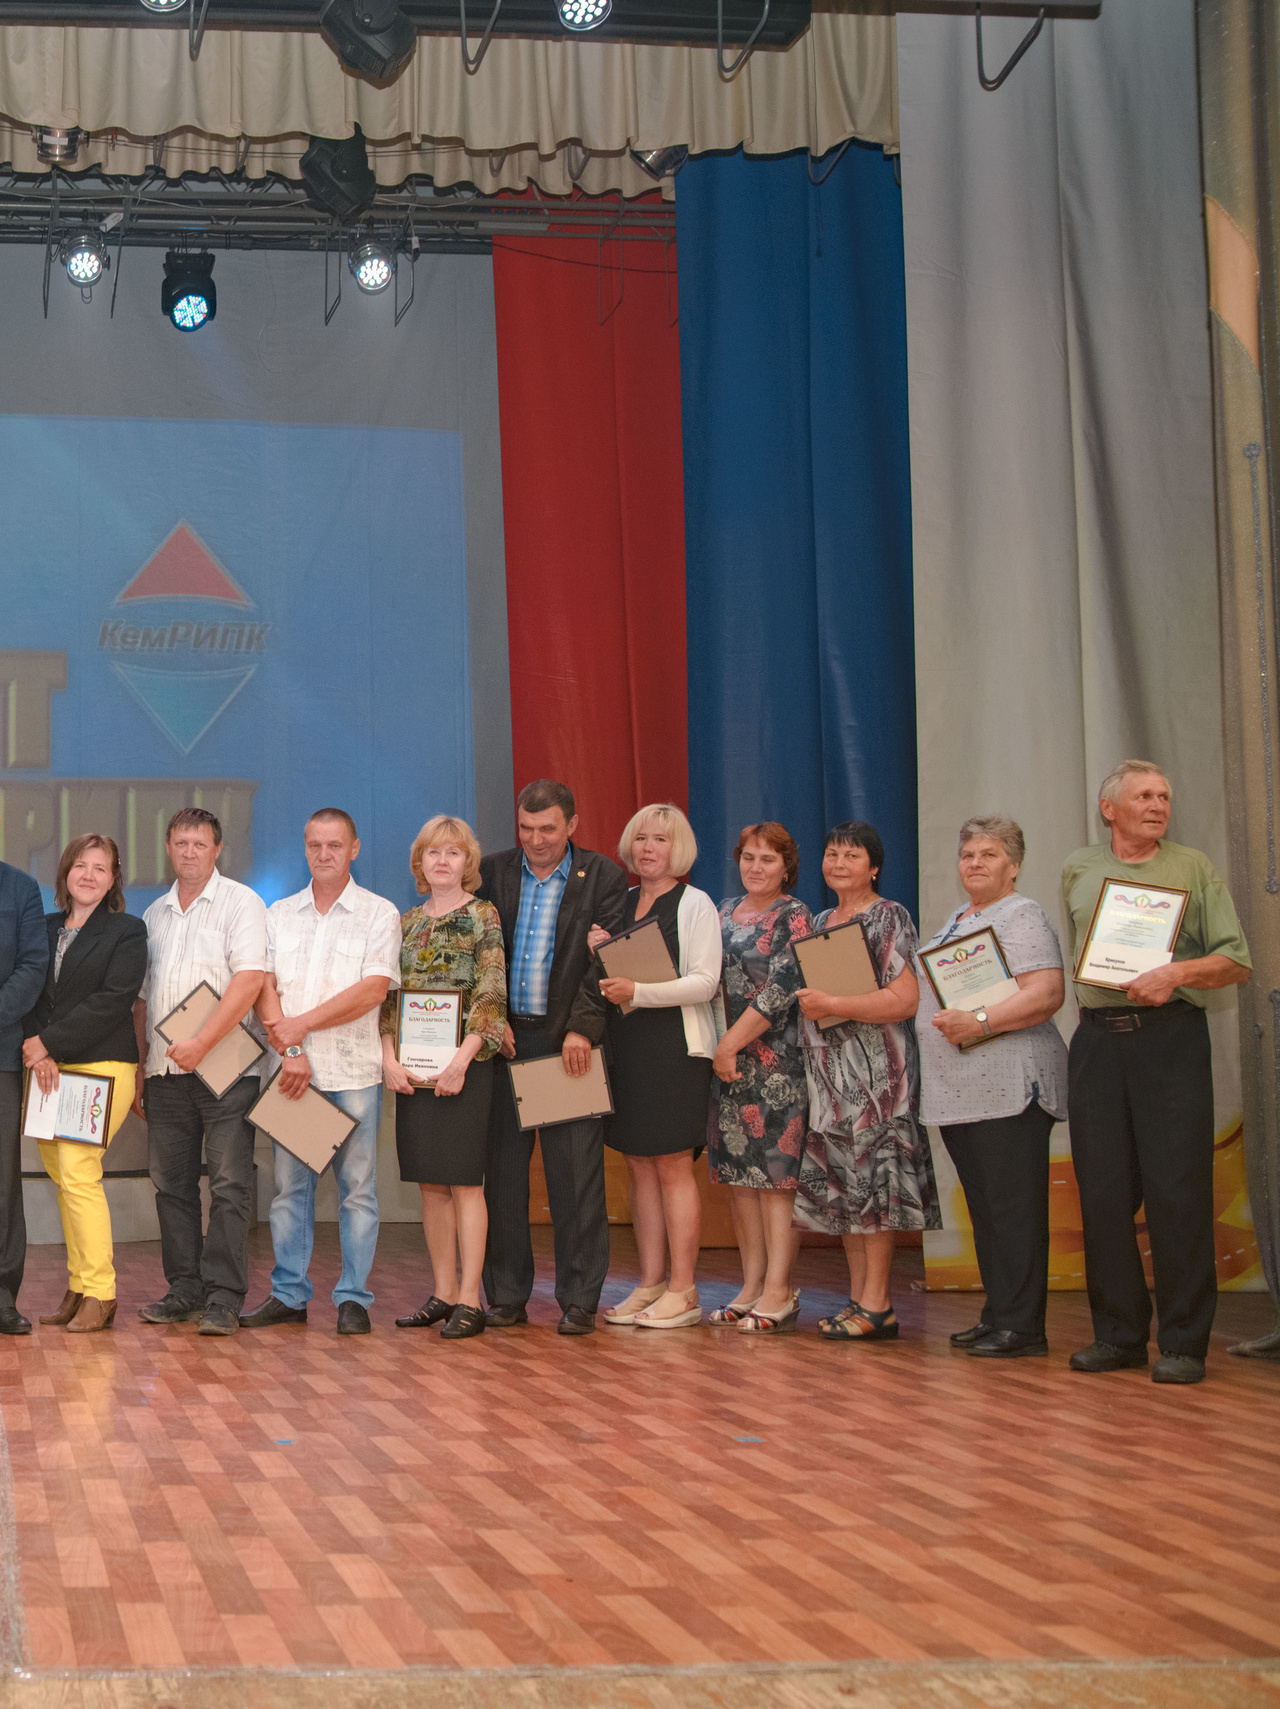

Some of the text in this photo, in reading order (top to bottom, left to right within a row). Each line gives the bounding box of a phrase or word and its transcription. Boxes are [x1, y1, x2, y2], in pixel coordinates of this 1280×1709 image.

[98, 619, 271, 654] КемРИПК
[943, 959, 993, 981] БЛАГОДАРНОСТЬ
[1089, 962, 1110, 970] Владимир
[78, 1084, 89, 1132] БЛАГОДАРНОСТЬ
